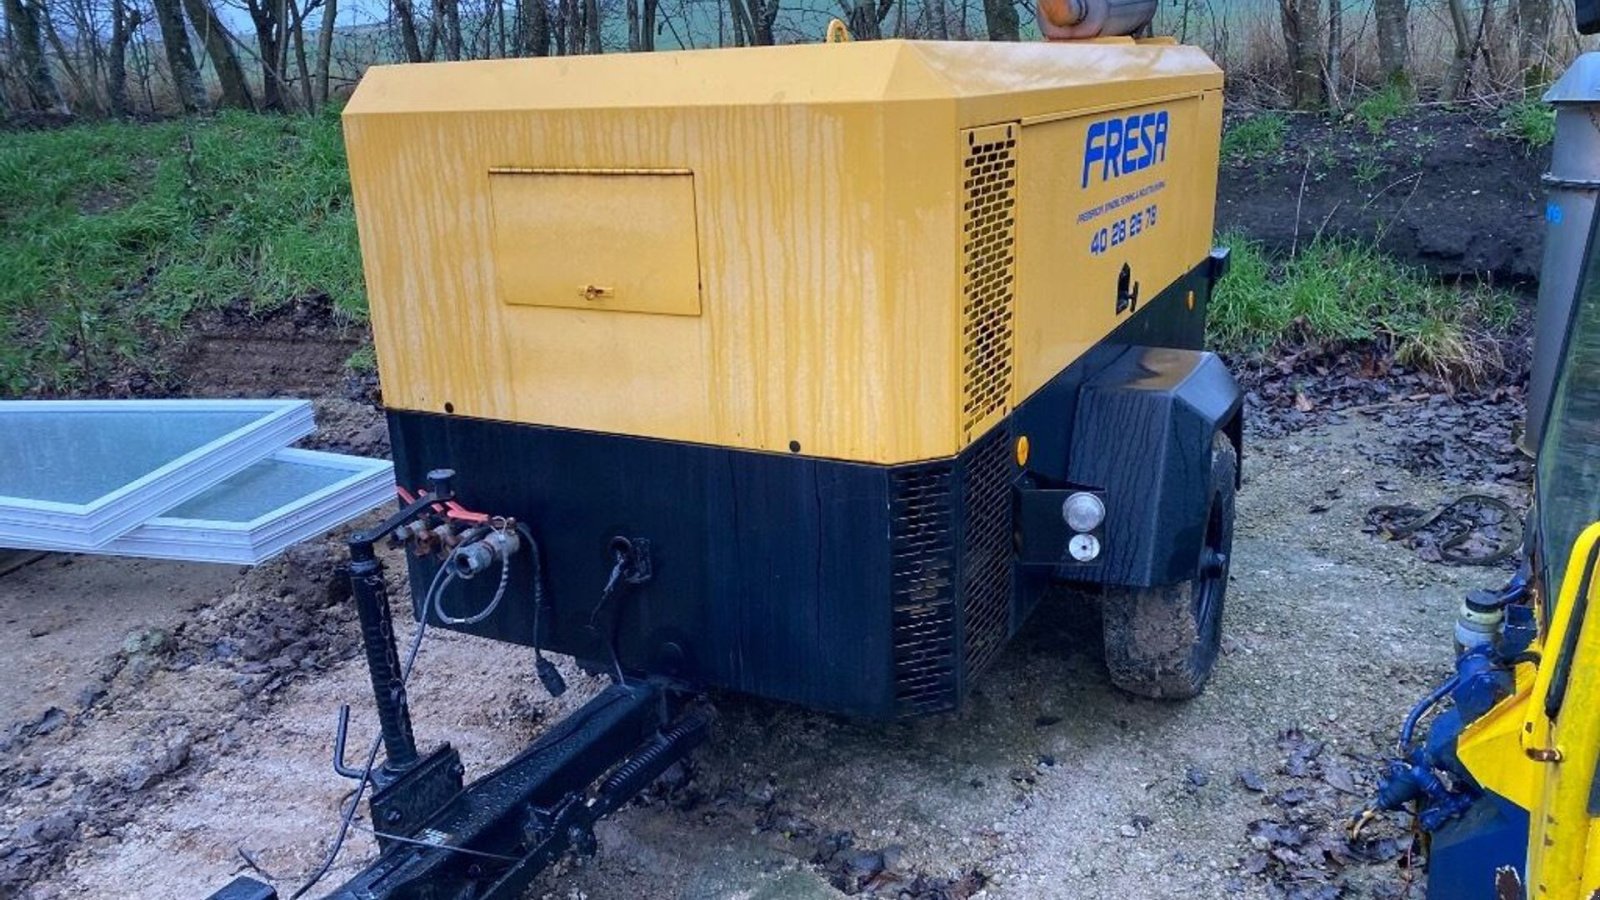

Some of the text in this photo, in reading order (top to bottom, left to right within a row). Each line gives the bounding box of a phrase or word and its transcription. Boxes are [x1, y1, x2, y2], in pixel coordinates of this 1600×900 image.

[1081, 111, 1168, 189] FRESA
[1090, 229, 1108, 254] 40
[1111, 219, 1126, 246] 28
